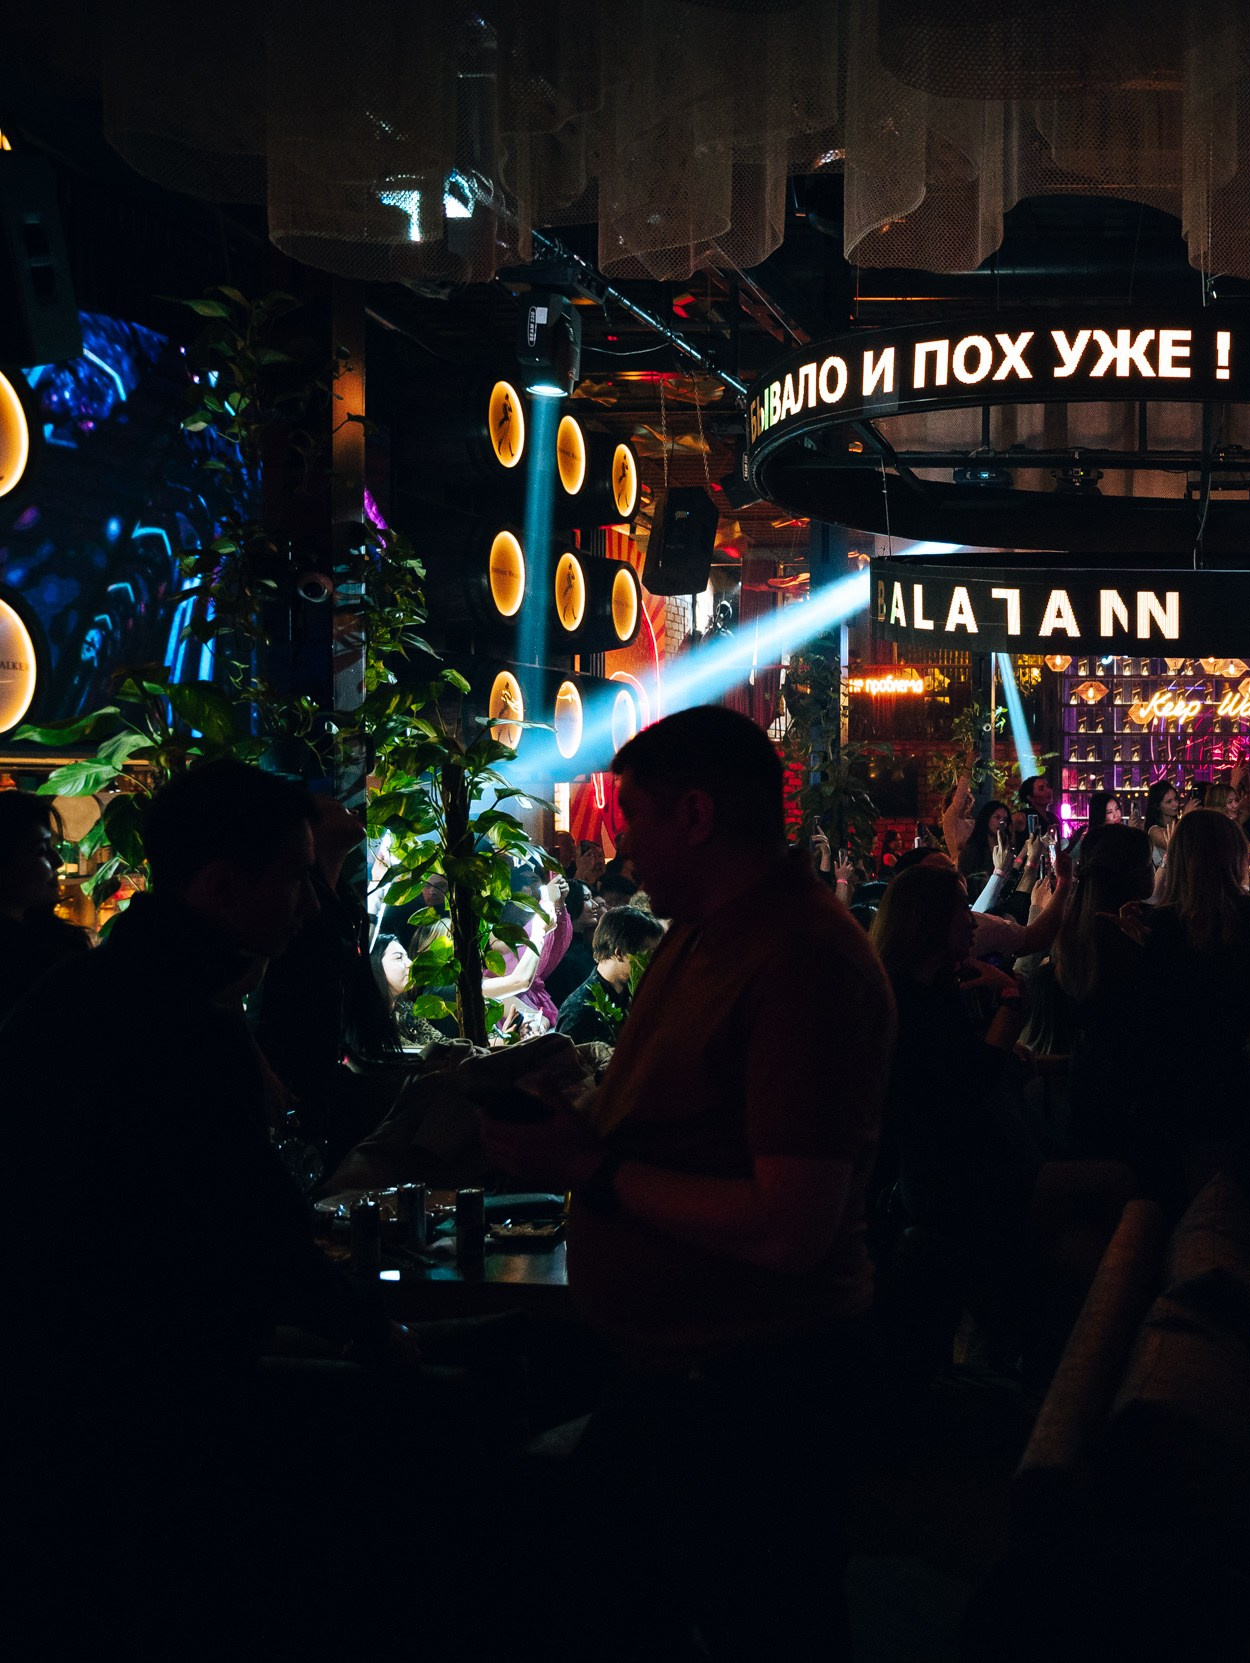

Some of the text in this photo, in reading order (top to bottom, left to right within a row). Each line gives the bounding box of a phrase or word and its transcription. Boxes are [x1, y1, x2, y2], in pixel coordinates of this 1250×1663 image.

[862, 347, 895, 396] И
[913, 331, 1034, 388] ПОХ
[1051, 330, 1192, 378] УЖЕ
[1139, 691, 1202, 726] Keep
